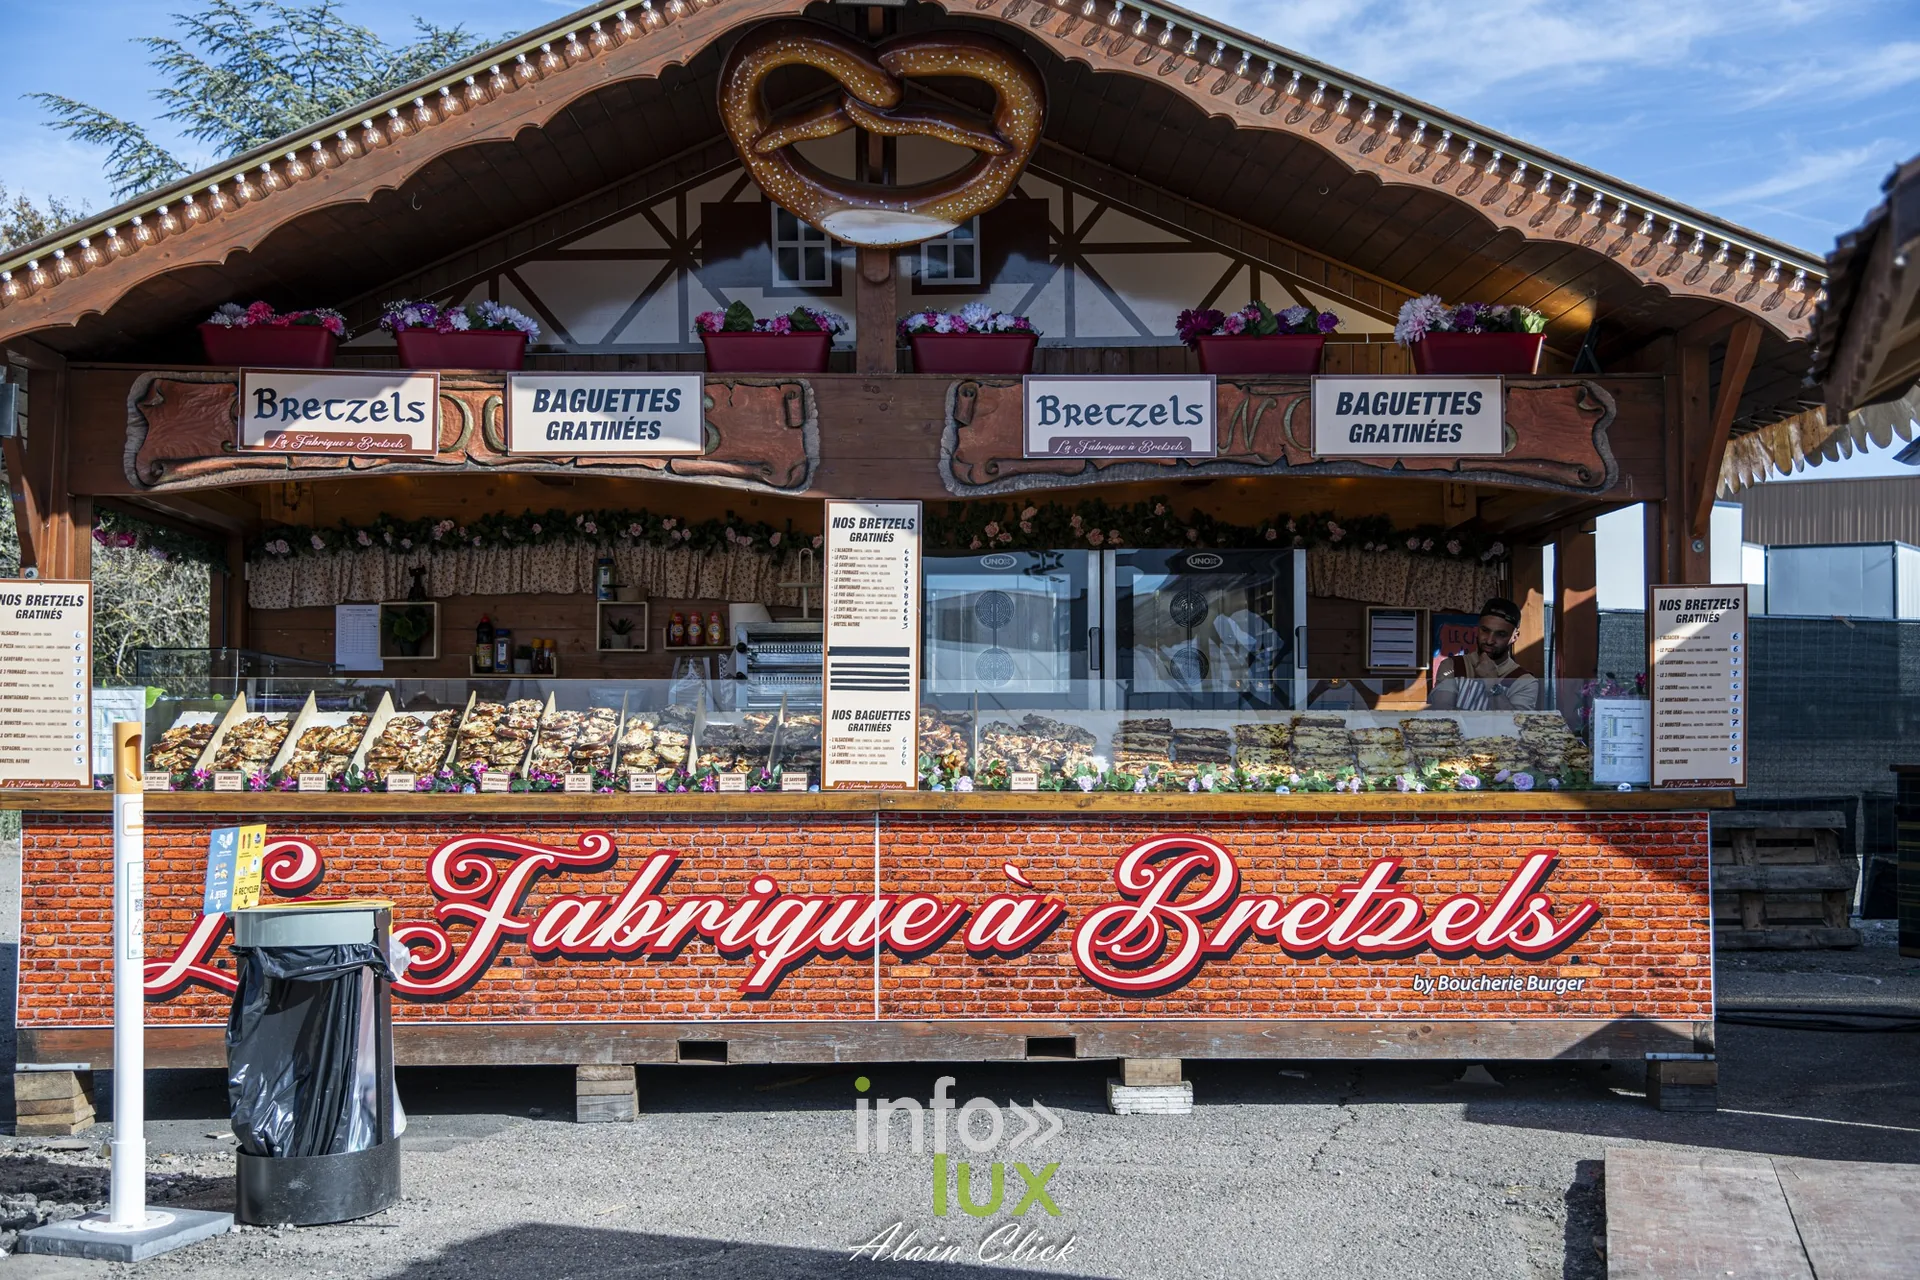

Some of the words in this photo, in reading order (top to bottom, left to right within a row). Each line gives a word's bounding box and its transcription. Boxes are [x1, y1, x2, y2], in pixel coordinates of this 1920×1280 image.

[252, 388, 426, 424] Bretzels
[532, 388, 681, 413] BAGUETTES
[1335, 391, 1483, 416] BAGUETTES
[1036, 394, 1204, 428] Bretzels
[546, 416, 662, 440] GRATINÉES
[1349, 418, 1463, 443] GRATINÉES
[268, 434, 288, 450] La
[291, 434, 348, 450] Fabrique
[348, 439, 355, 447] à
[1052, 440, 1072, 454] La
[1074, 440, 1128, 455] Fabrique
[1128, 442, 1136, 452] à
[832, 517, 855, 529] NOS
[858, 518, 915, 530] BRETZELS
[850, 530, 894, 542] GRATINÉS
[0, 594, 22, 606] NOS
[26, 595, 84, 607] BRETZELS
[1658, 600, 1681, 611] NOS
[1684, 598, 1740, 611] BRETZELS
[16, 608, 62, 620] GRATINÉS
[1676, 611, 1720, 624] GRATINÉS
[831, 710, 852, 720] NOS
[854, 710, 911, 721] BAGUETTES
[848, 722, 892, 732] GRATINÉES
[392, 830, 969, 1003] Fabrique
[963, 861, 1068, 959] à
[1412, 974, 1436, 996] by
[1438, 974, 1522, 992] Boucherie
[1526, 976, 1586, 996] Burger
